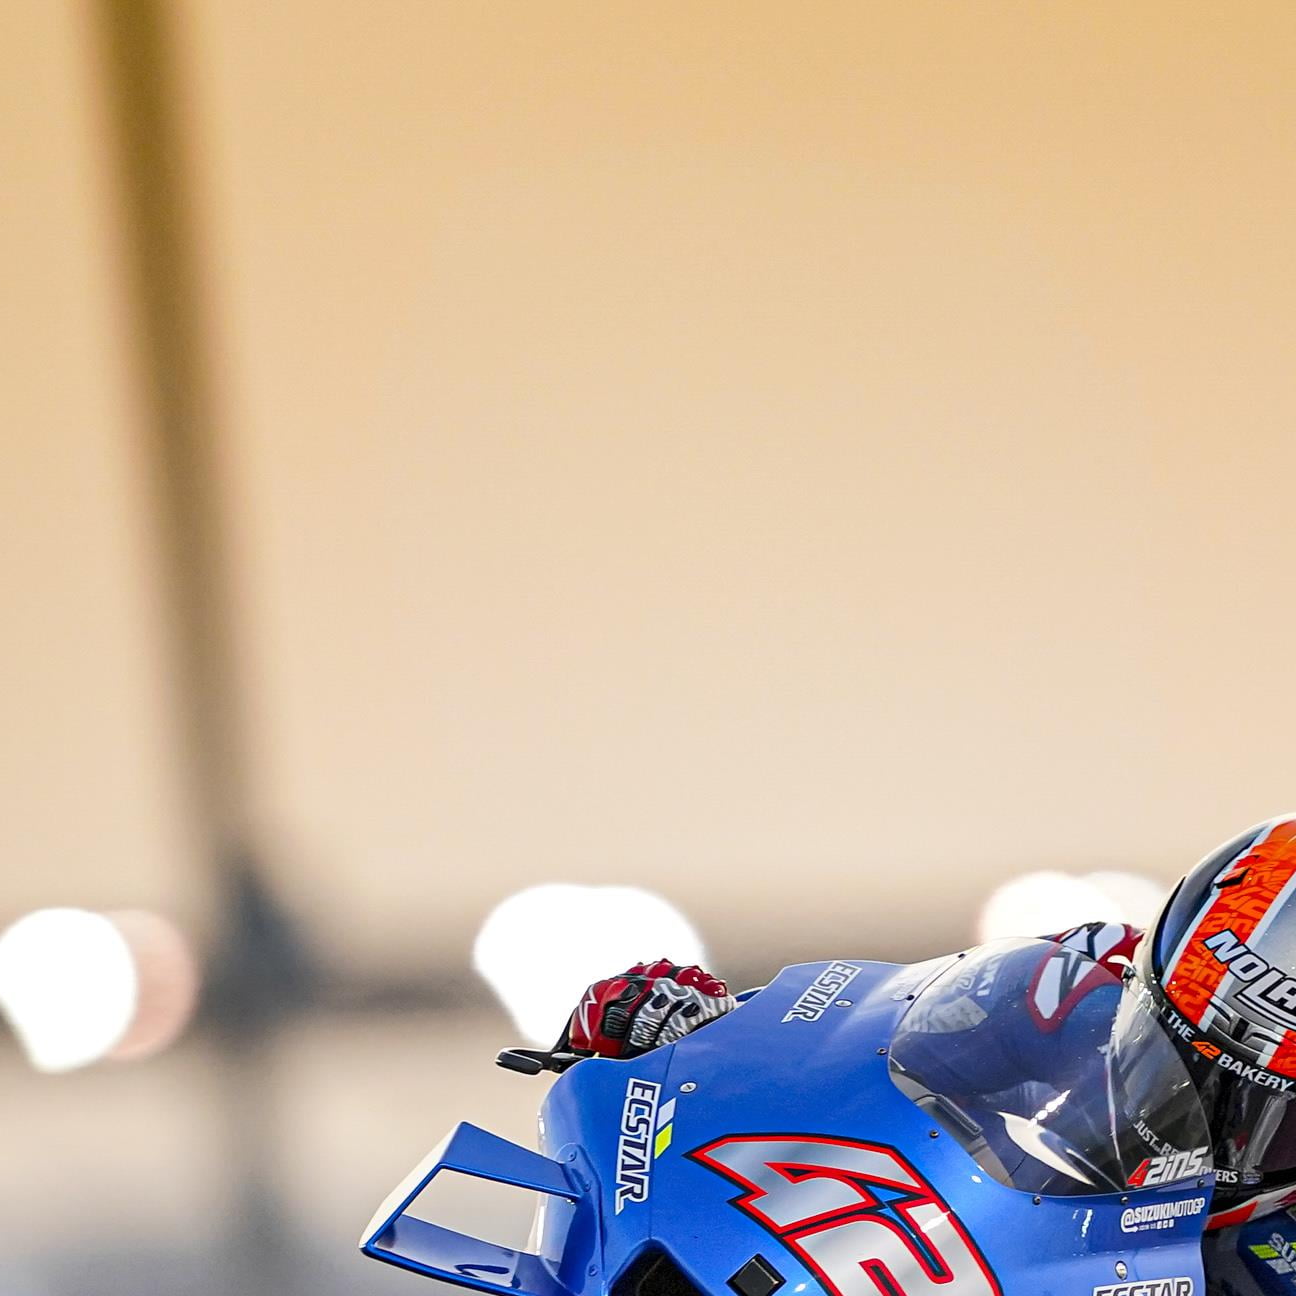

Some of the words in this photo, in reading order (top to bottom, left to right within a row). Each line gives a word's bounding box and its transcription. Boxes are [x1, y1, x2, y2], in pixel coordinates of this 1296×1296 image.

[781, 960, 861, 1025] ECSTAR
[1166, 1009, 1194, 1042] THE
[1191, 1041, 1221, 1061] 42
[1217, 1053, 1295, 1093] BAKERY
[615, 1077, 661, 1214] ECSTAR
[1133, 1119, 1161, 1147] JUST
[1121, 1197, 1205, 1230] @SUZUKIMOTOGP
